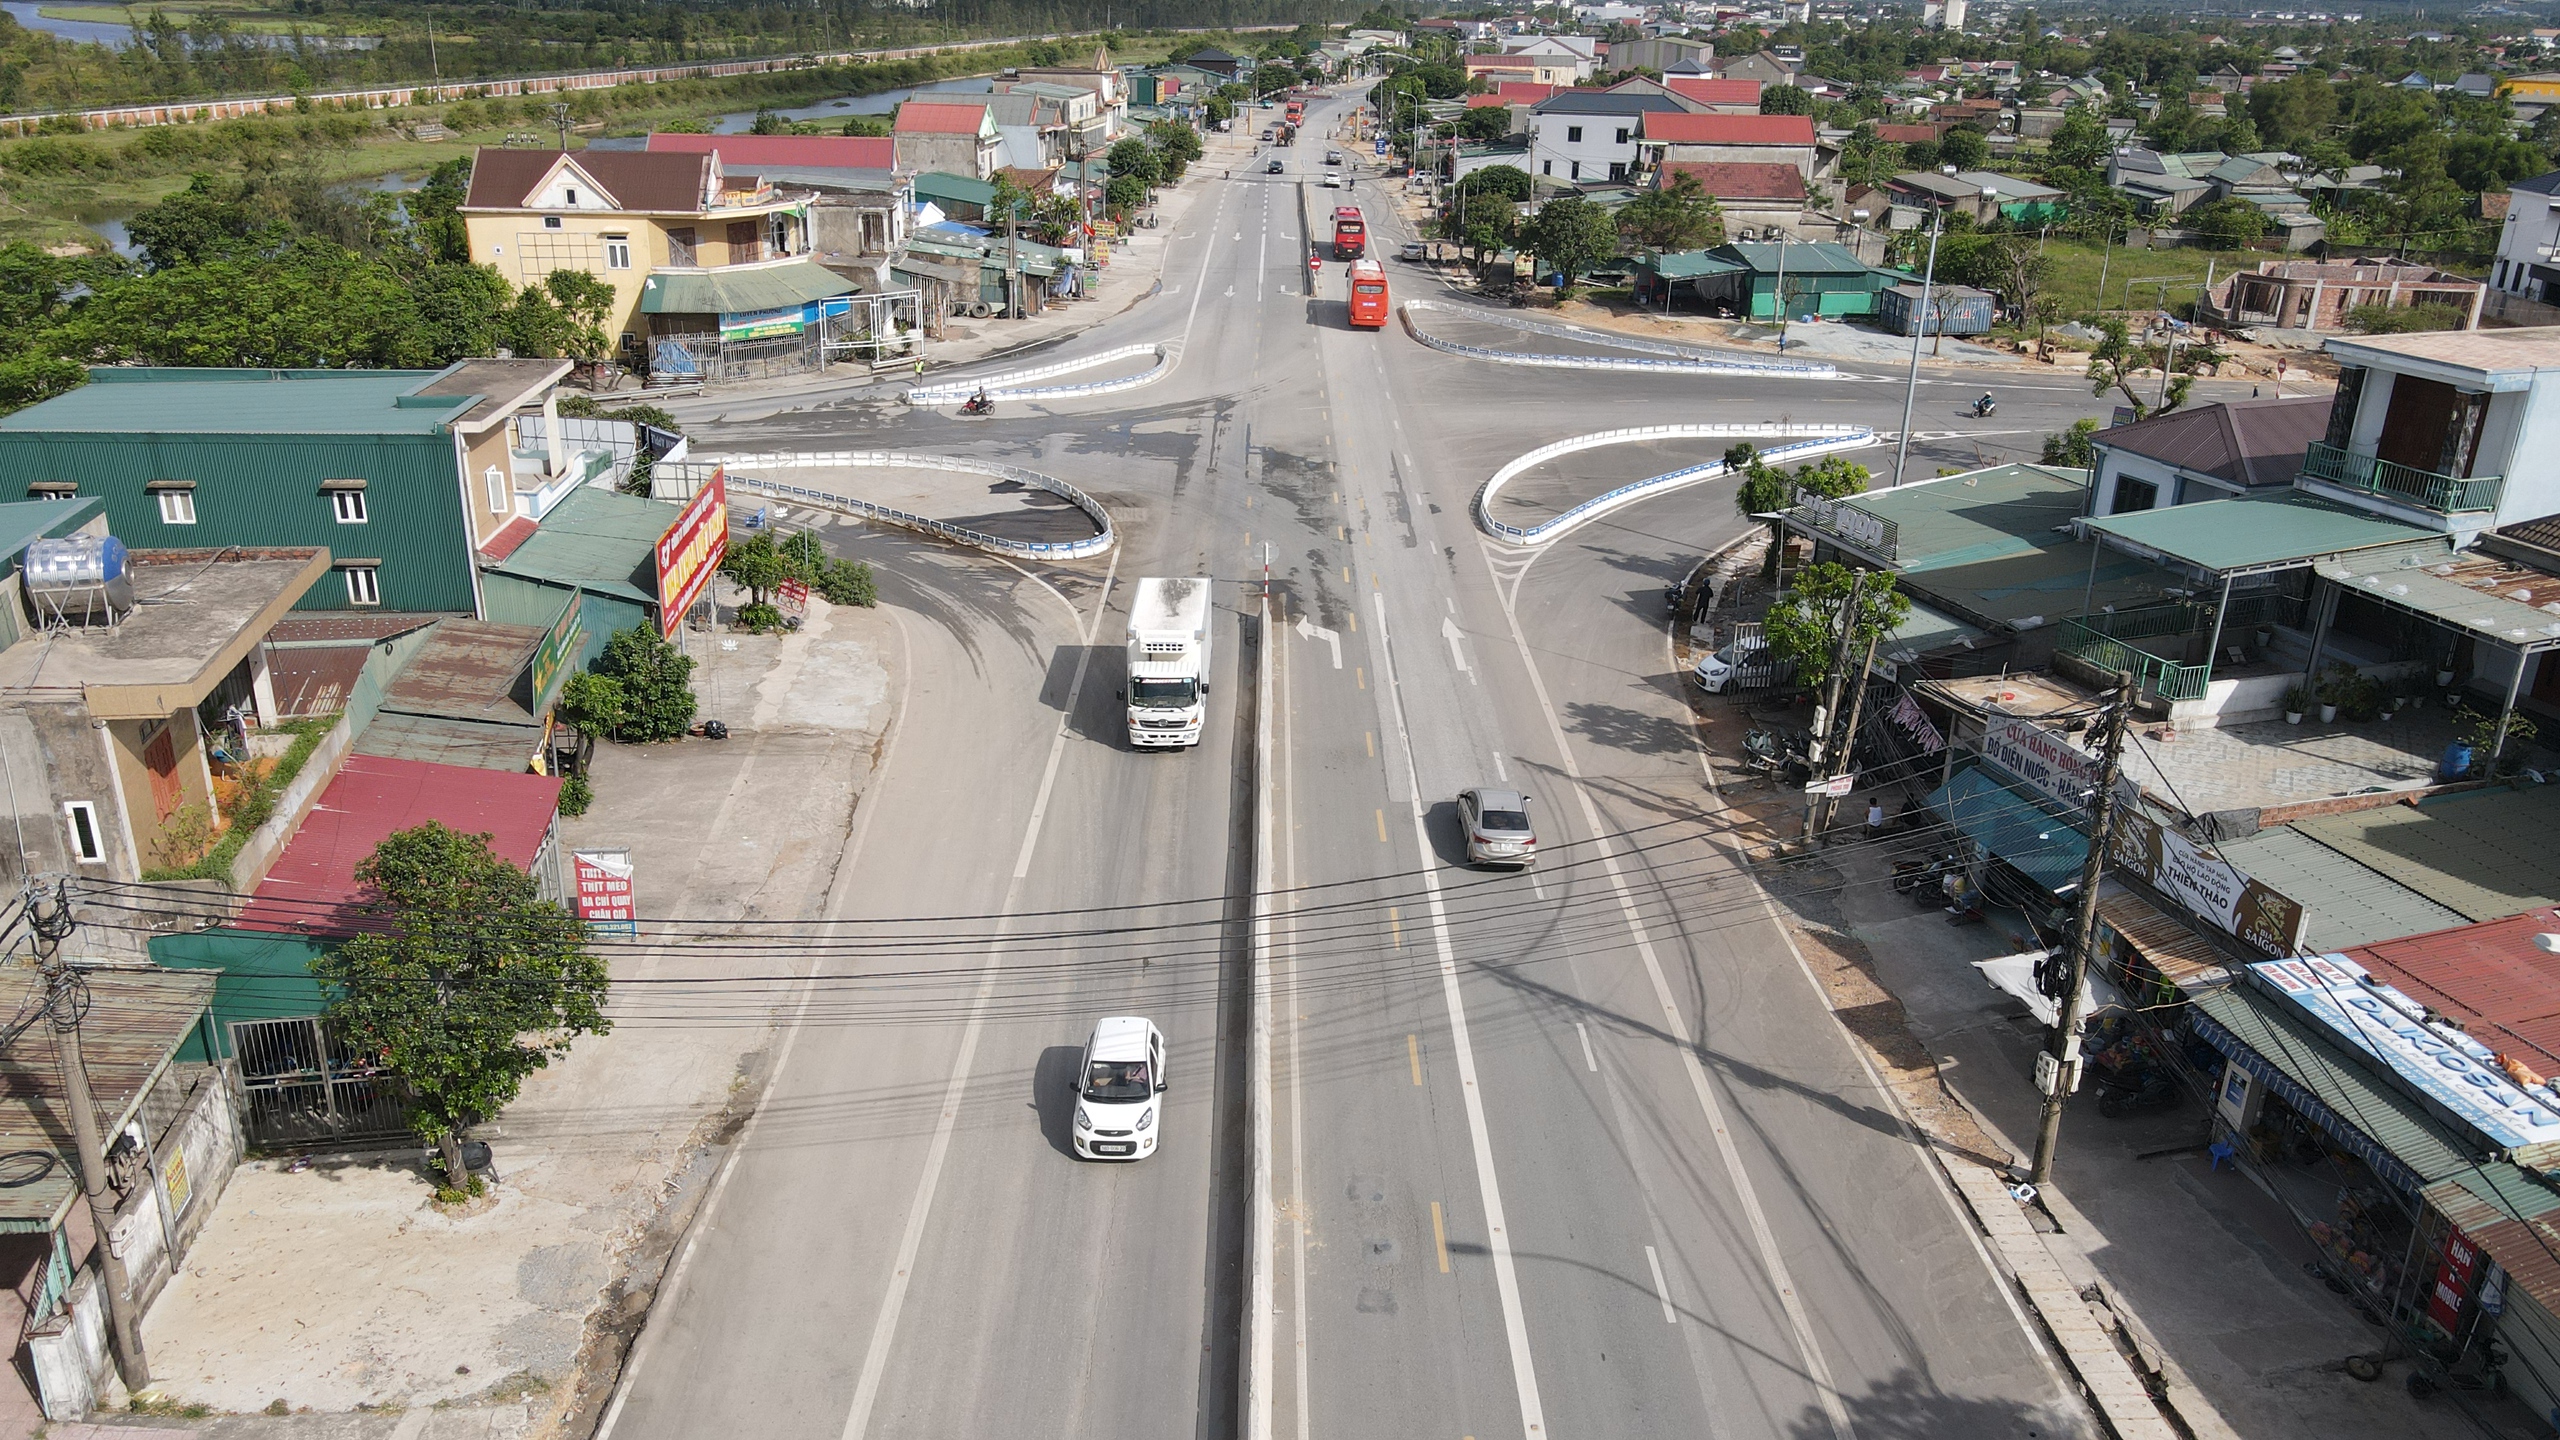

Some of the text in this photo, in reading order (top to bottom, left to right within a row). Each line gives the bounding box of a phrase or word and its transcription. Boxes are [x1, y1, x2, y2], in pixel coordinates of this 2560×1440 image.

[1836, 507, 1884, 547] 1999
[2029, 736, 2056, 763] HÀNG
[2001, 746, 2022, 772] ĐIỆN
[2024, 759, 2050, 787] NƯỚC
[580, 868, 602, 879] THỊT
[2197, 869, 2210, 883] LAO
[581, 880, 627, 893] THỊT MÈO
[2199, 885, 2228, 909] THẢO
[582, 897, 593, 907] BA
[611, 895, 631, 907] QUAY
[612, 907, 627, 919] GIÒ
[2244, 928, 2286, 959] SAIGON
[2260, 928, 2273, 941] BIA
[2345, 997, 2560, 1126] DAIKIOSAN
[2455, 1083, 2488, 1105] CAO
